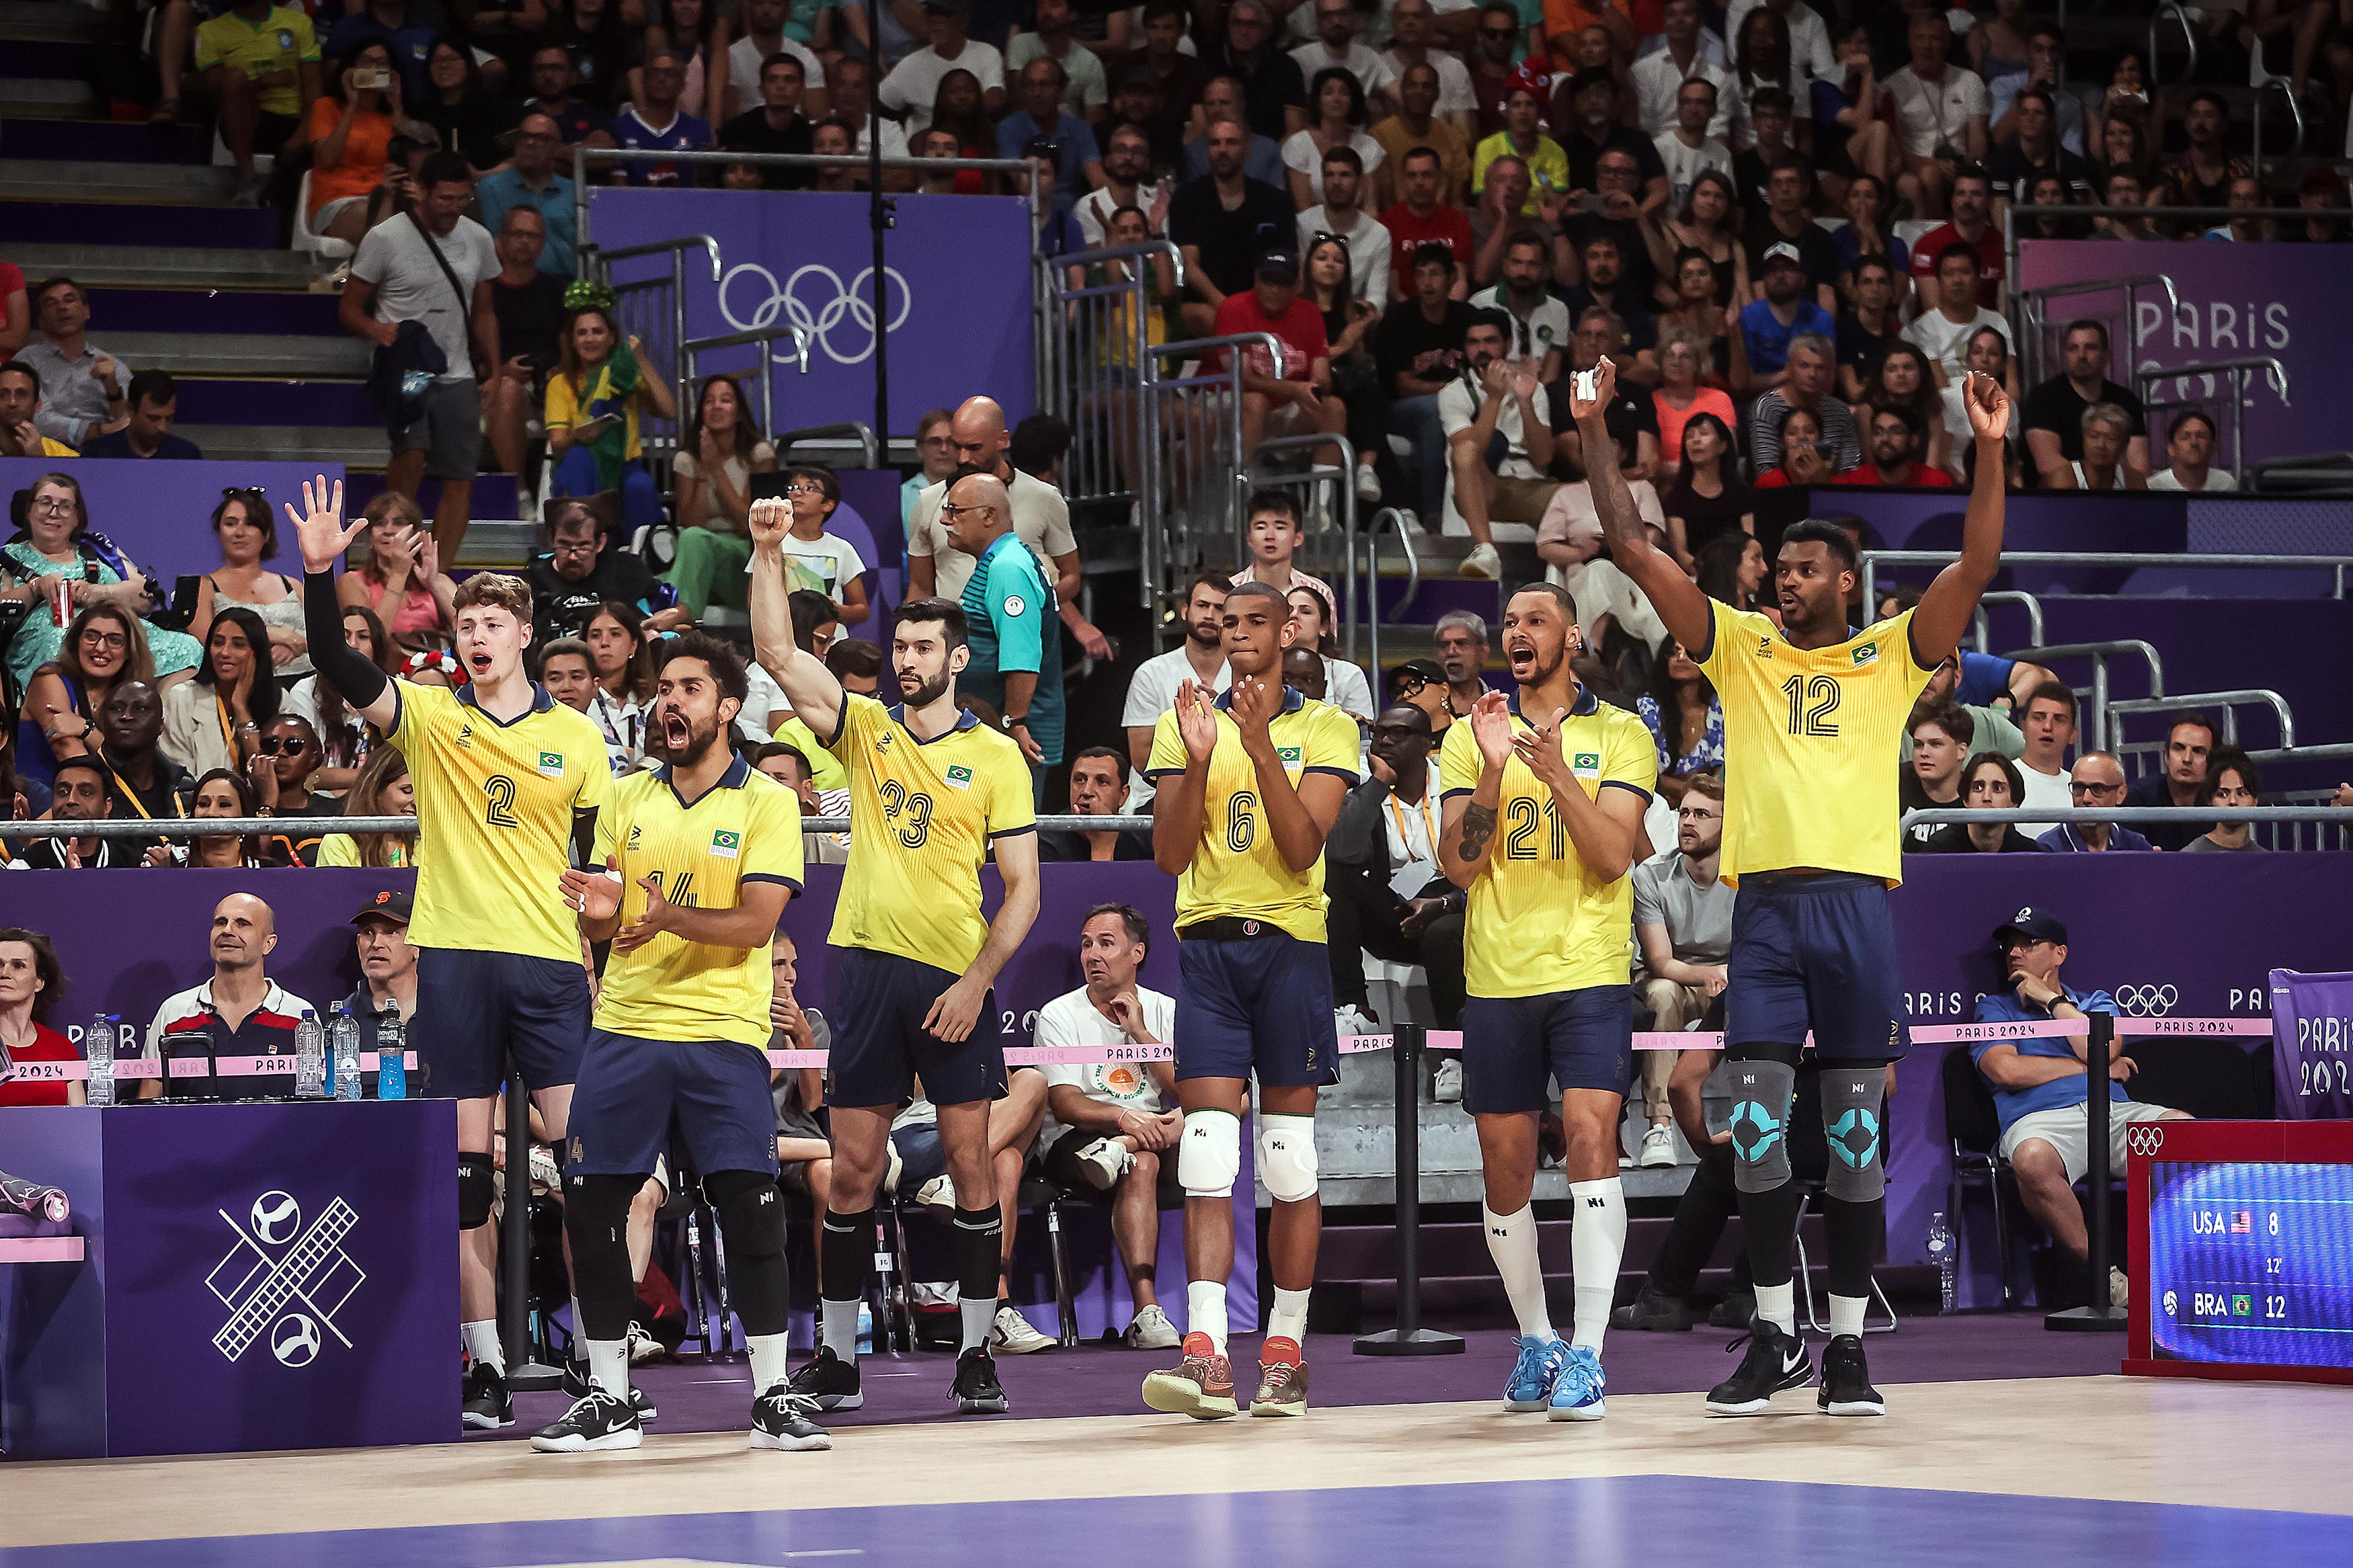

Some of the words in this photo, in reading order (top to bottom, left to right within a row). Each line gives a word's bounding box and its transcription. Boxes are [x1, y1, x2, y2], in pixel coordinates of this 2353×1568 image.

[1781, 674, 1841, 737] 12
[1573, 768, 1597, 777] BRASIL
[483, 774, 518, 829] 2
[879, 779, 933, 849] 23
[1227, 791, 1257, 852] 6
[1507, 796, 1565, 860] 21
[711, 845, 736, 857] BRASIL
[2000, 1026, 2036, 1036] 2024
[2199, 1021, 2234, 1033] 2024
[19, 1065, 63, 1078] 2024
[2193, 1210, 2226, 1235] USA
[2268, 1212, 2278, 1235] 8
[2194, 1292, 2228, 1316] BRA
[2266, 1295, 2286, 1318] 12
